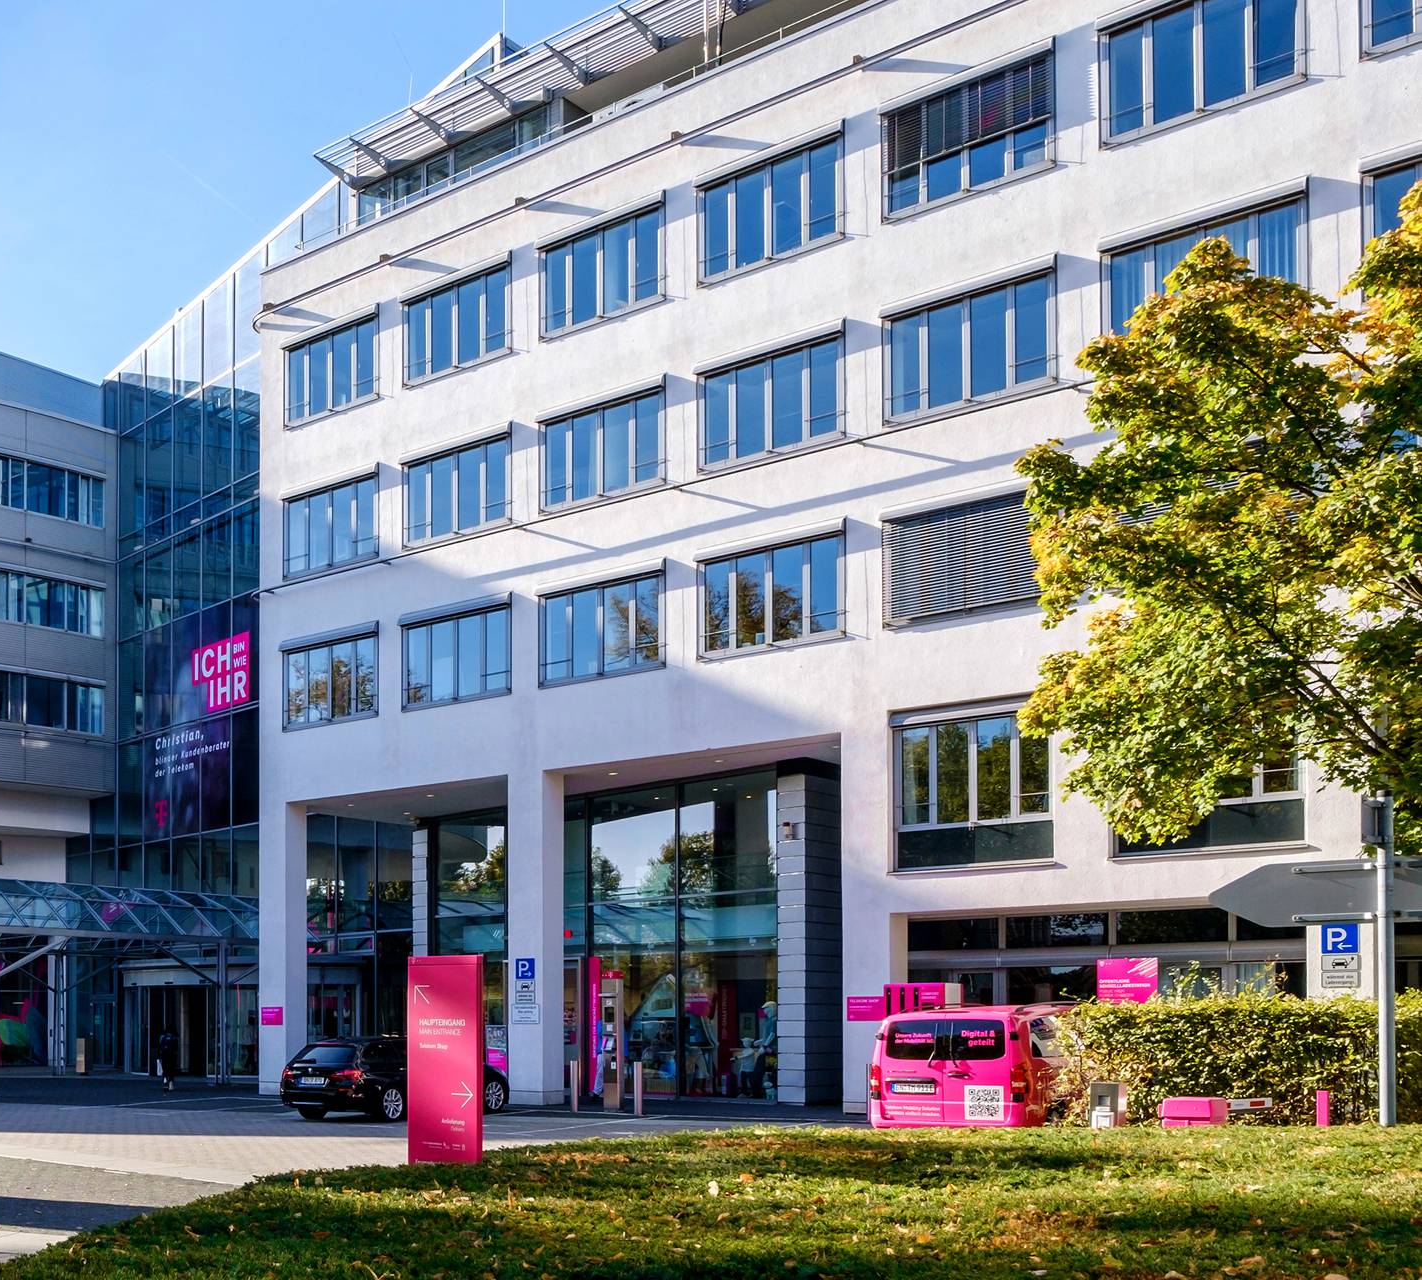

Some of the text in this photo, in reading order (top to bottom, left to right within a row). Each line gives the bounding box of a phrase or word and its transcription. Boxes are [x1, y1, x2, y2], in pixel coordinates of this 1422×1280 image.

[233, 641, 245, 654] BIN
[194, 642, 231, 681] ICH
[233, 655, 247, 668] WIE
[209, 670, 247, 708] IHR
[155, 730, 205, 750] Christian,
[180, 741, 230, 759] Kundenberater
[154, 762, 195, 778] der Telekom
[1327, 927, 1347, 951] P
[518, 961, 529, 977] P
[418, 1018, 466, 1027] HAUPTEINGANG
[960, 1030, 988, 1039] Digital
[968, 1039, 995, 1047] geteilt
